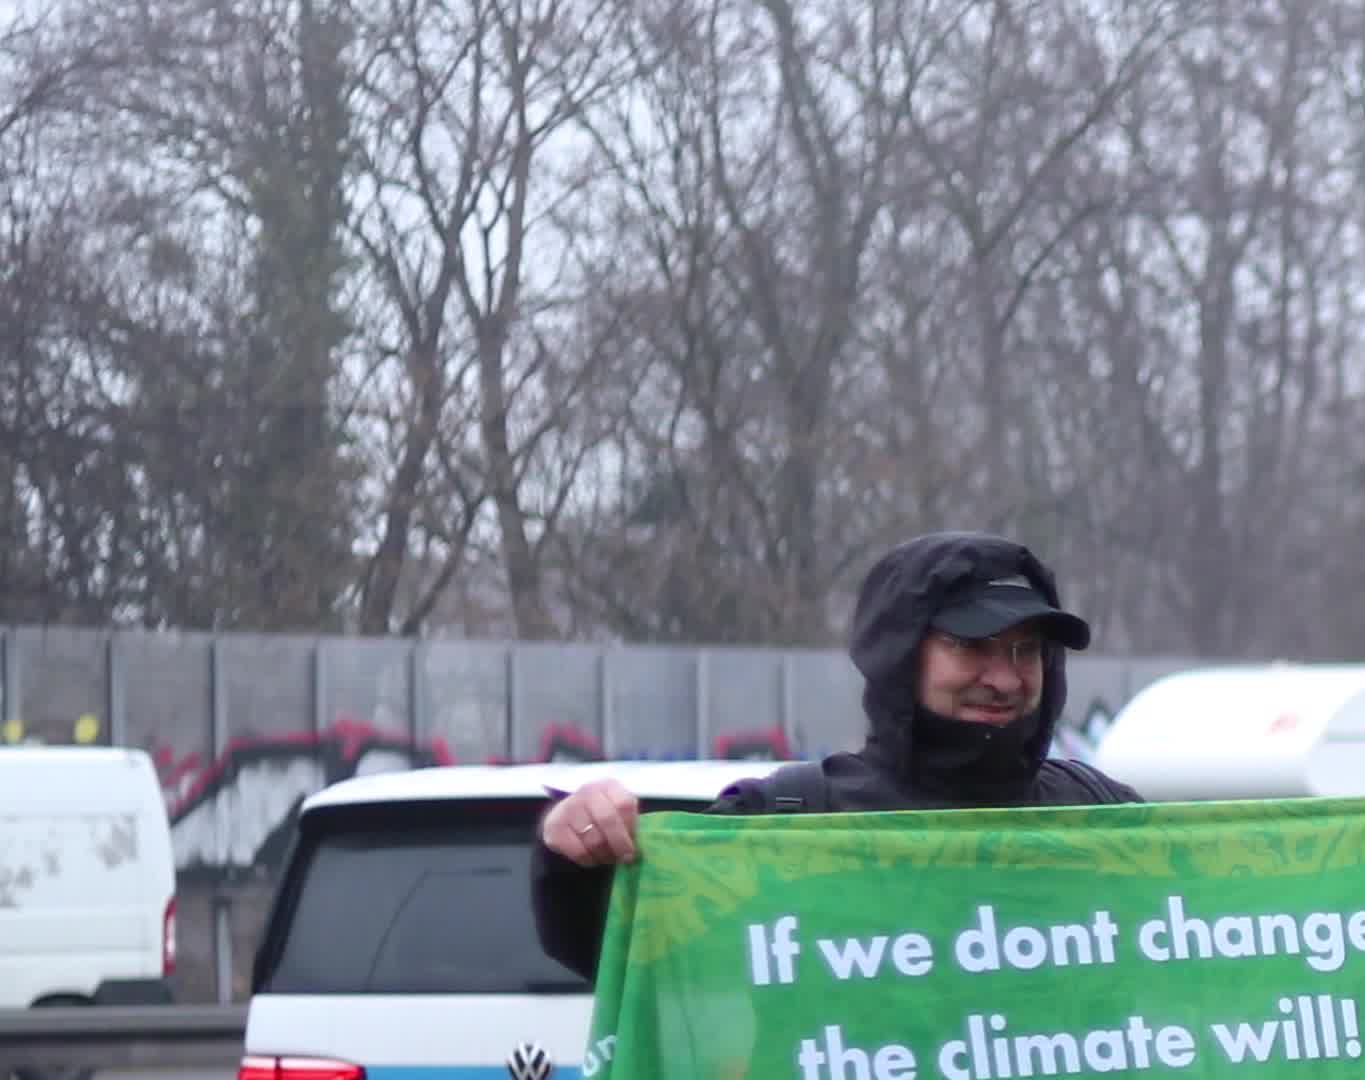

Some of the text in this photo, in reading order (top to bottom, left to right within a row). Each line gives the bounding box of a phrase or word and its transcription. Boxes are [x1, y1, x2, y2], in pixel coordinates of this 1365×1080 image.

[748, 915, 800, 985] If
[817, 933, 933, 979] we
[955, 905, 1119, 972] dont
[1210, 994, 1362, 1063] will!
